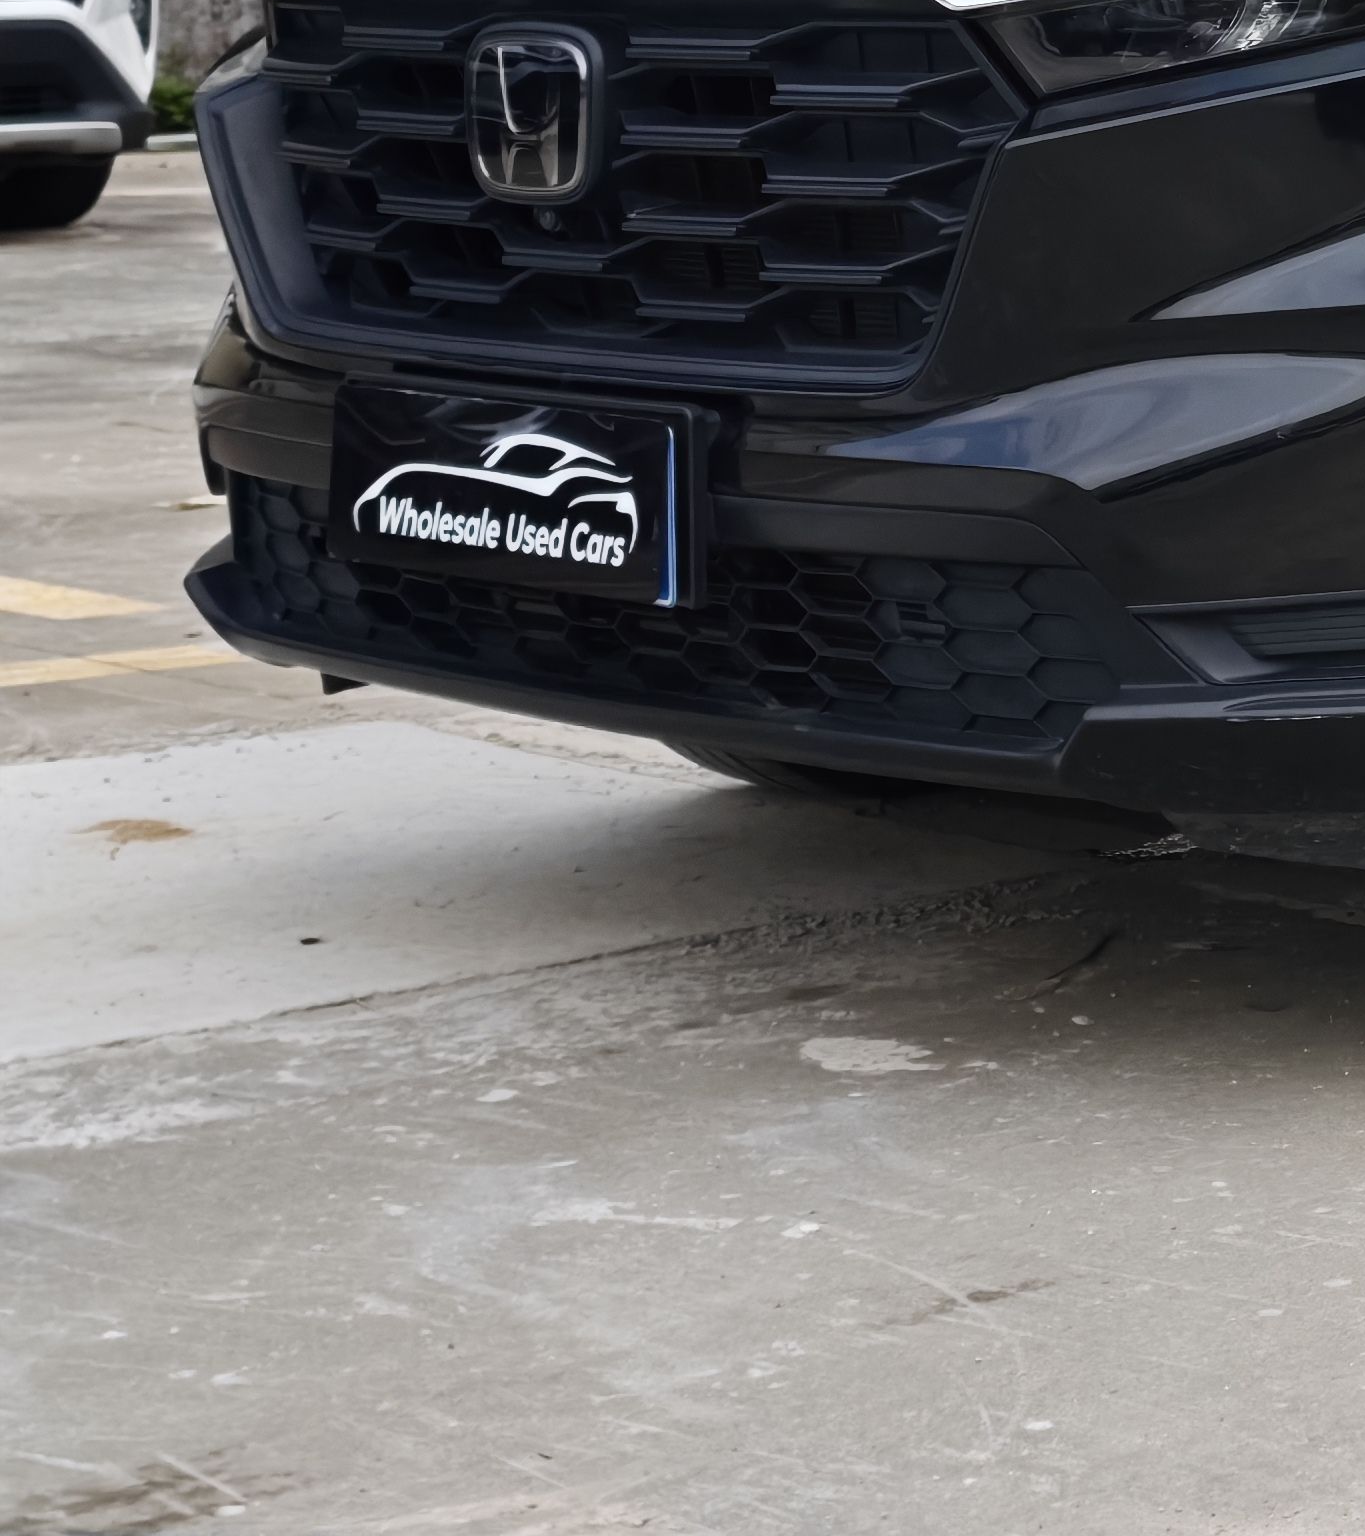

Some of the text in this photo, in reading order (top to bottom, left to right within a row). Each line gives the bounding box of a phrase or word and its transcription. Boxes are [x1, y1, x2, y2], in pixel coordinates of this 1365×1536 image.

[379, 495, 626, 567] Wholesale Used Cars
